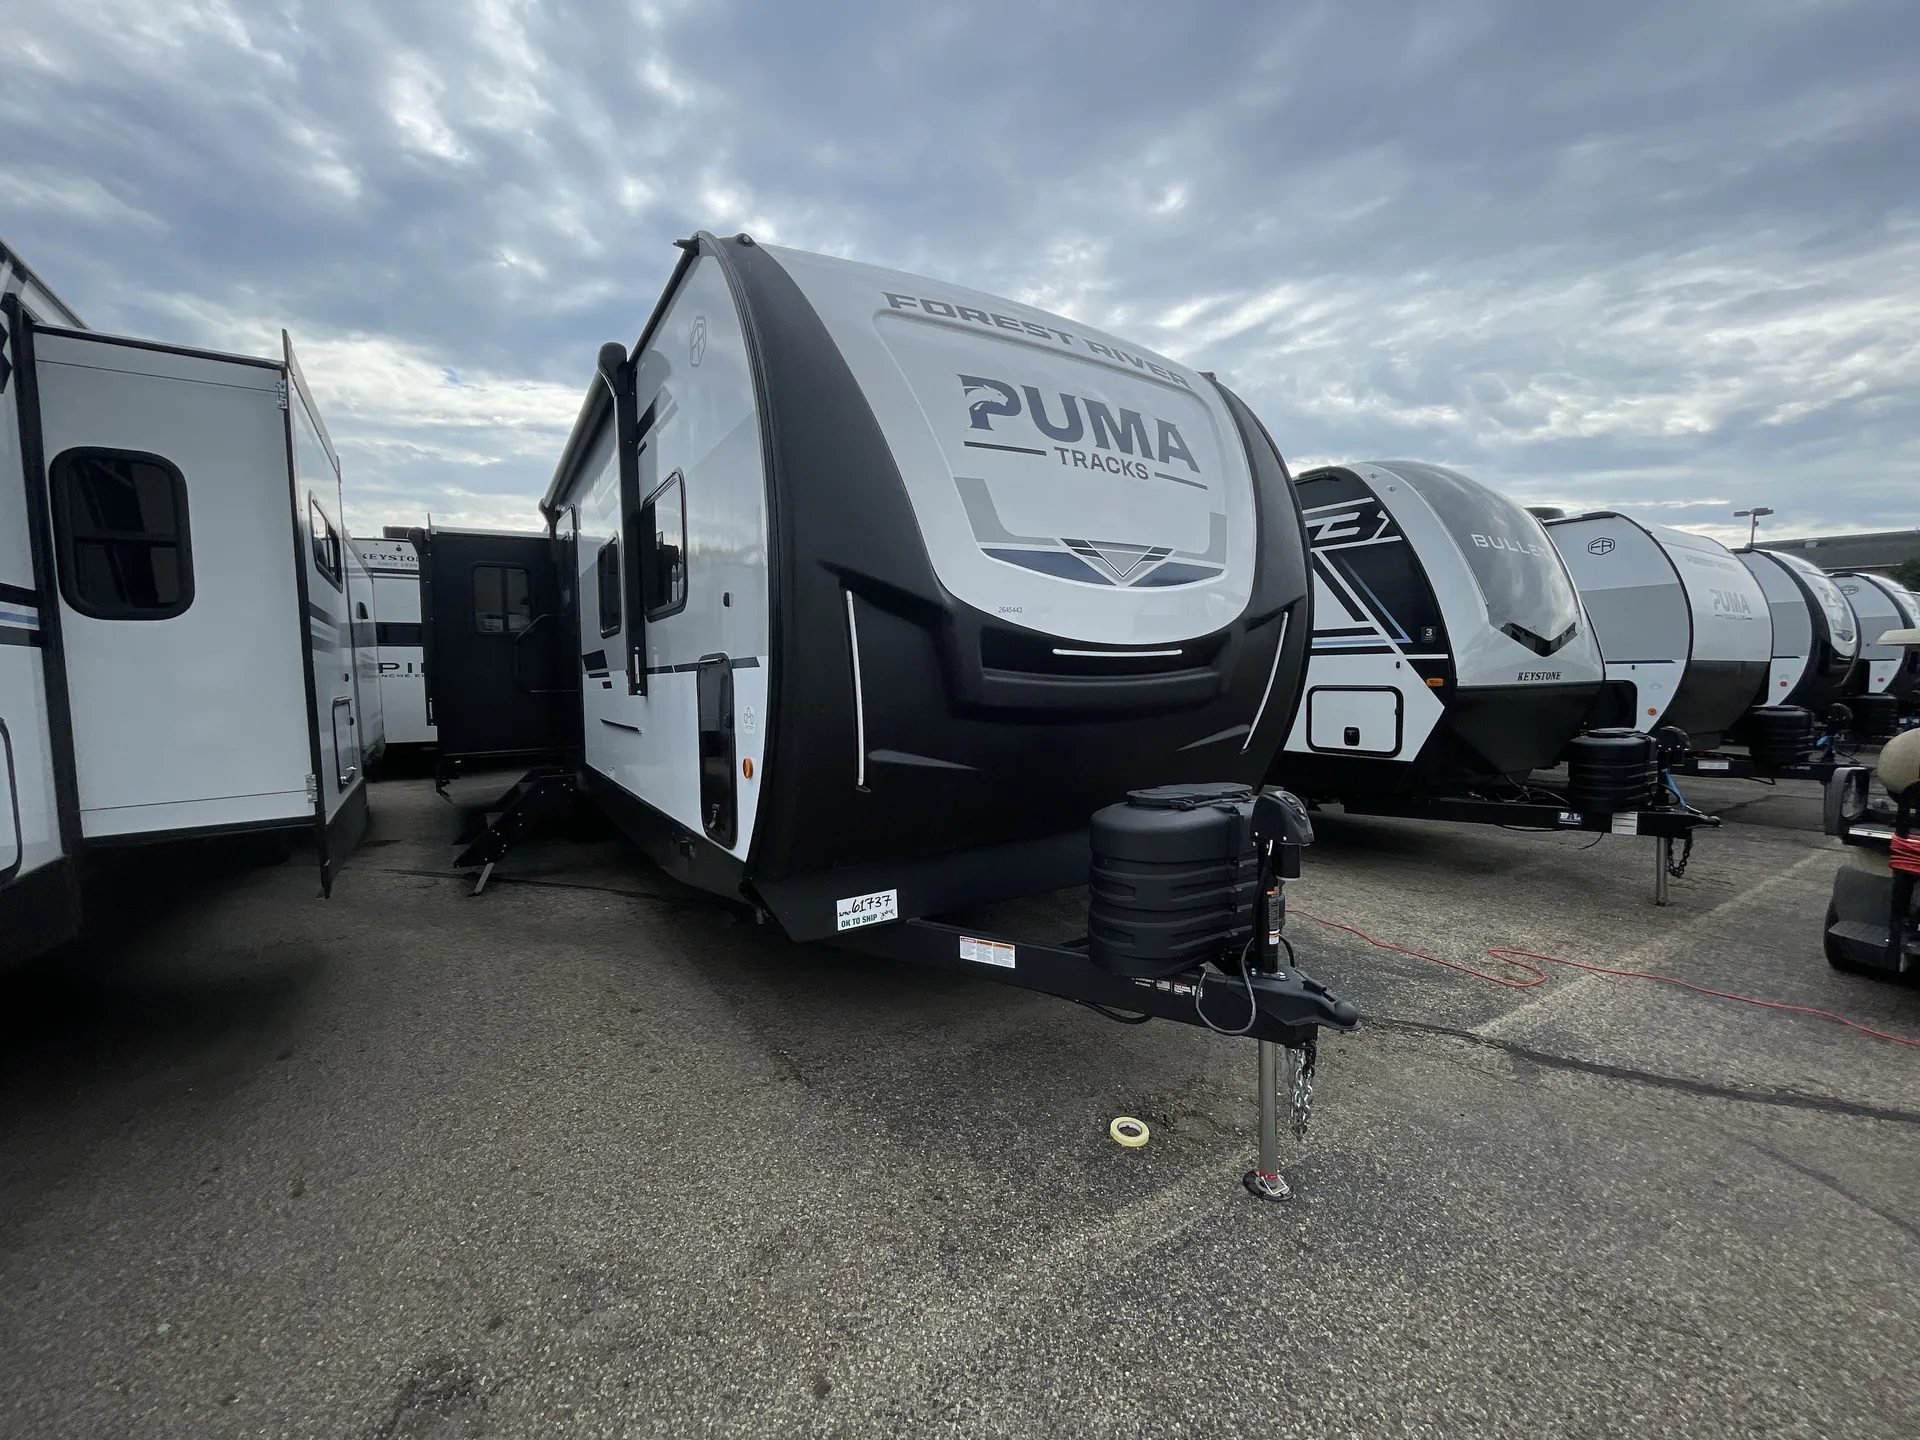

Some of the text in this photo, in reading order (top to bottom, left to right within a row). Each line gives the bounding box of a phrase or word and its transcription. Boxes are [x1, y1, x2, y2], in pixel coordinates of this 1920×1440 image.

[881, 291, 1193, 391] FOREST RIVER
[957, 373, 1201, 474] PUMA
[1053, 446, 1149, 480] TRACKS
[1470, 533, 1552, 559] BULLET
[1709, 588, 1751, 614] PUMA
[1425, 628, 1433, 637] 3
[1516, 671, 1562, 681] KEYSTONE
[851, 894, 892, 914] 61737
[841, 919, 851, 928] OK
[852, 917, 861, 926] TO
[862, 913, 878, 923] SHIP
